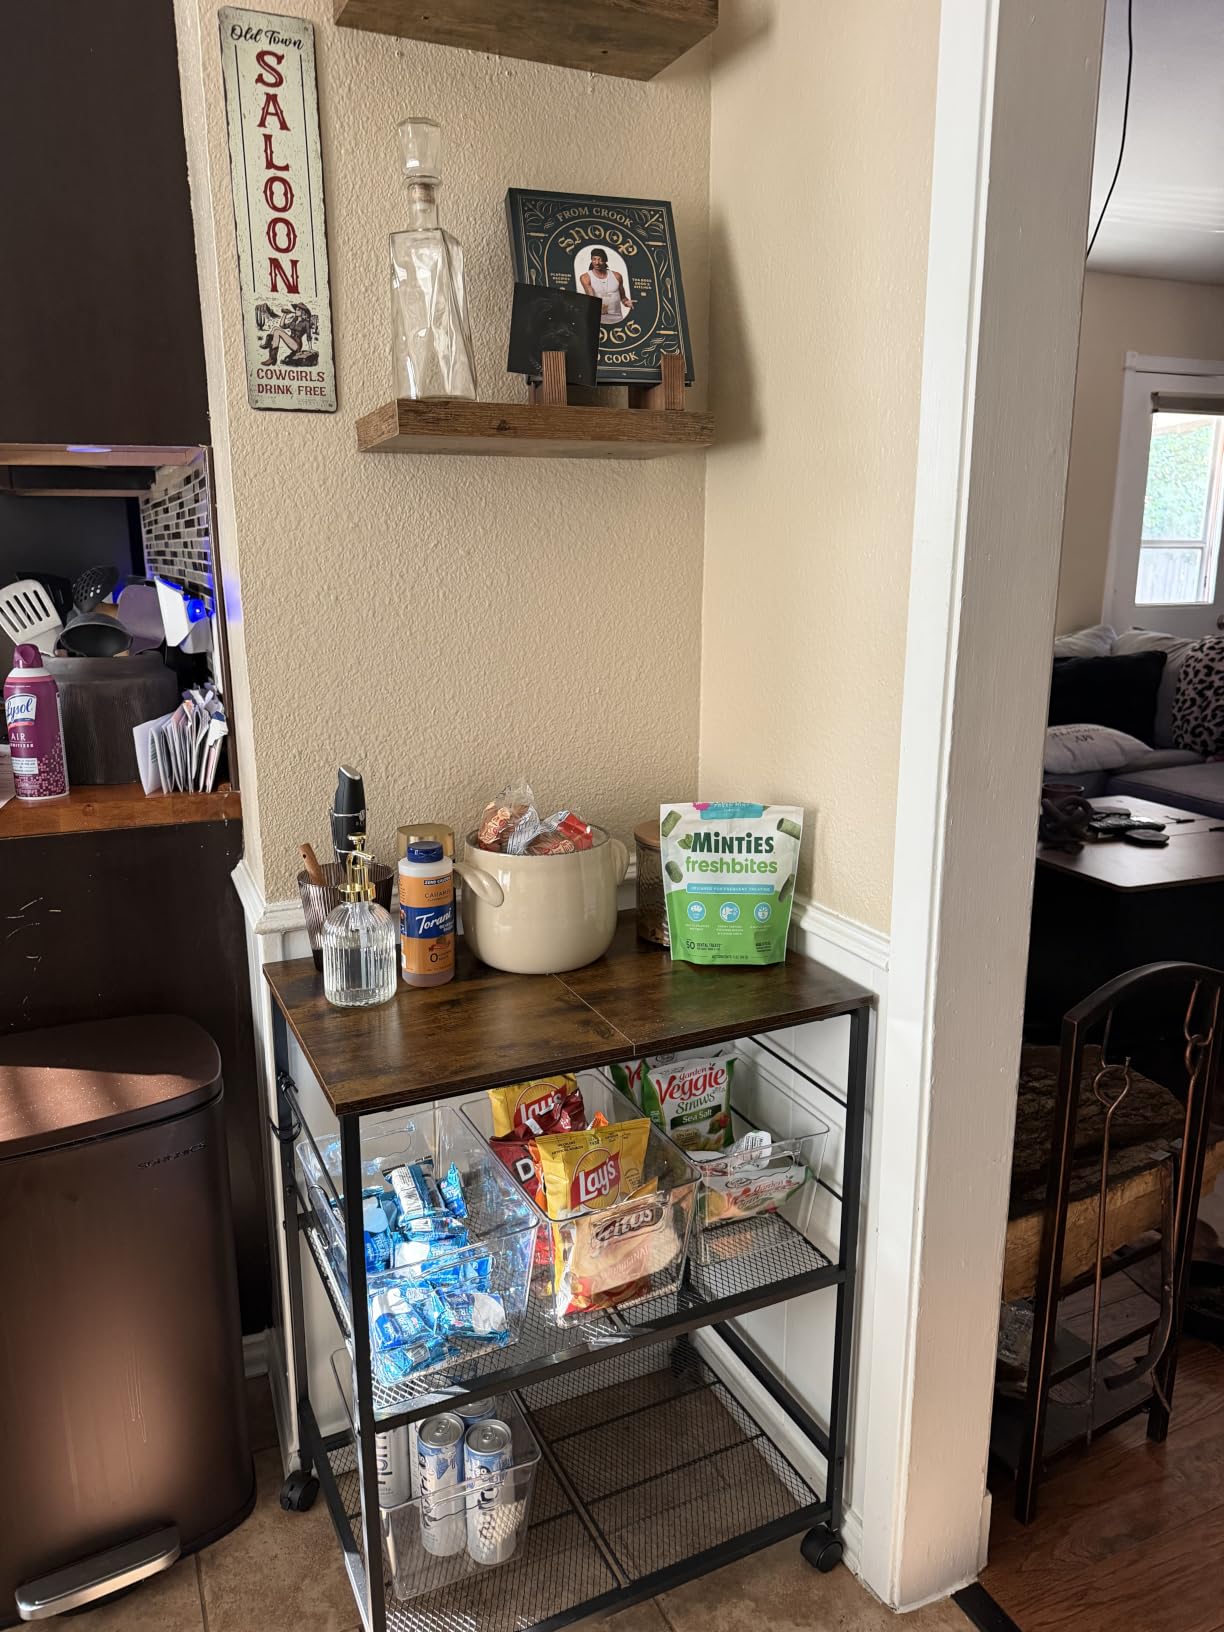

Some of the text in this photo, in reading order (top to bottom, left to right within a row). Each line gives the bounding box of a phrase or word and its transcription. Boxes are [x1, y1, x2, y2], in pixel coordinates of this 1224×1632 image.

[230, 24, 304, 50] Old Town
[255, 49, 300, 294] SALOON
[556, 206, 634, 228] FROM CROOK
[604, 351, 640, 363] COOK
[256, 368, 325, 383] COWGIRLS
[257, 383, 327, 397] DRINK FREE
[7, 698, 33, 723] Lysol
[11, 732, 26, 741] AIR
[685, 856, 778, 874] freshbites
[415, 907, 452, 934] Torani
[655, 1067, 728, 1106] Veggie
[682, 1109, 713, 1124] Sea Salt
[578, 1158, 616, 1203] Lay's
